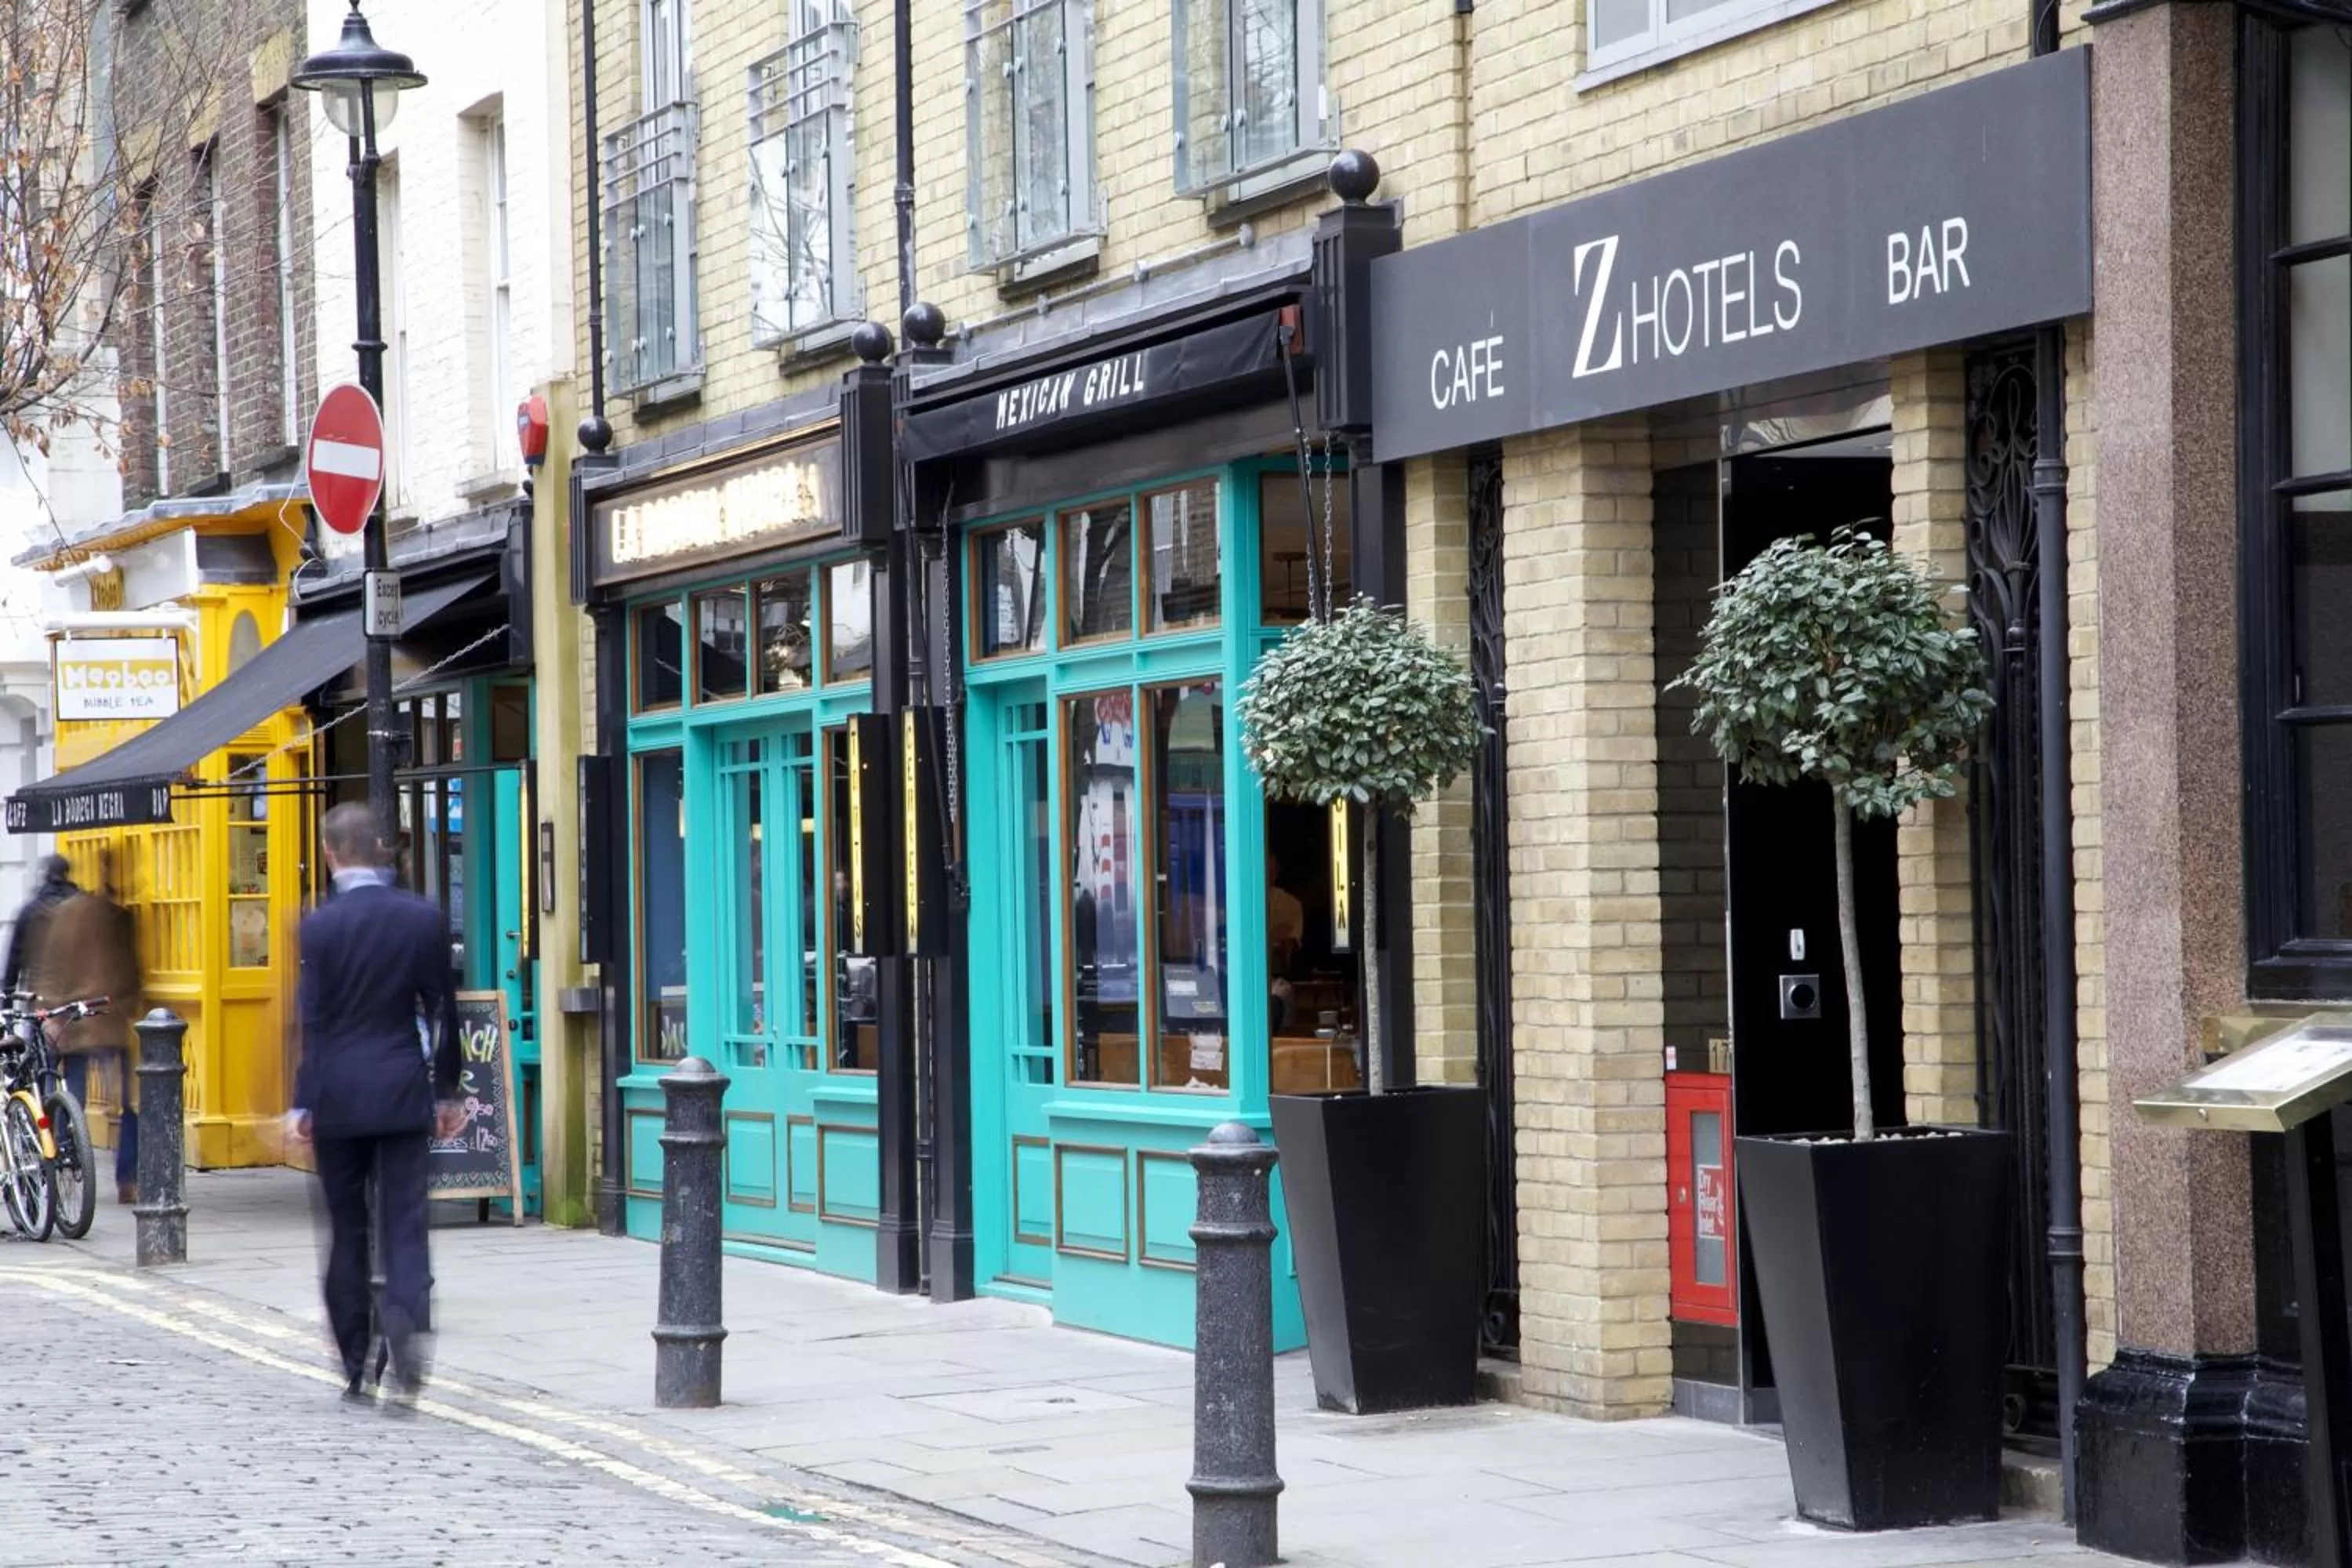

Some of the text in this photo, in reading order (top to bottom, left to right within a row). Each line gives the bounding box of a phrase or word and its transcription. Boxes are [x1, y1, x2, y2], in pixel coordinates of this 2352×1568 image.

[1431, 216, 1970, 409] CAFÉ Z HOTELS BAR
[995, 354, 1145, 431] MEXICAN GRILL
[52, 800, 62, 826] LA
[65, 793, 95, 824] BODEGA
[98, 791, 125, 820] NEGRA
[152, 786, 168, 818] BAR
[1712, 1042, 1729, 1072] 17
